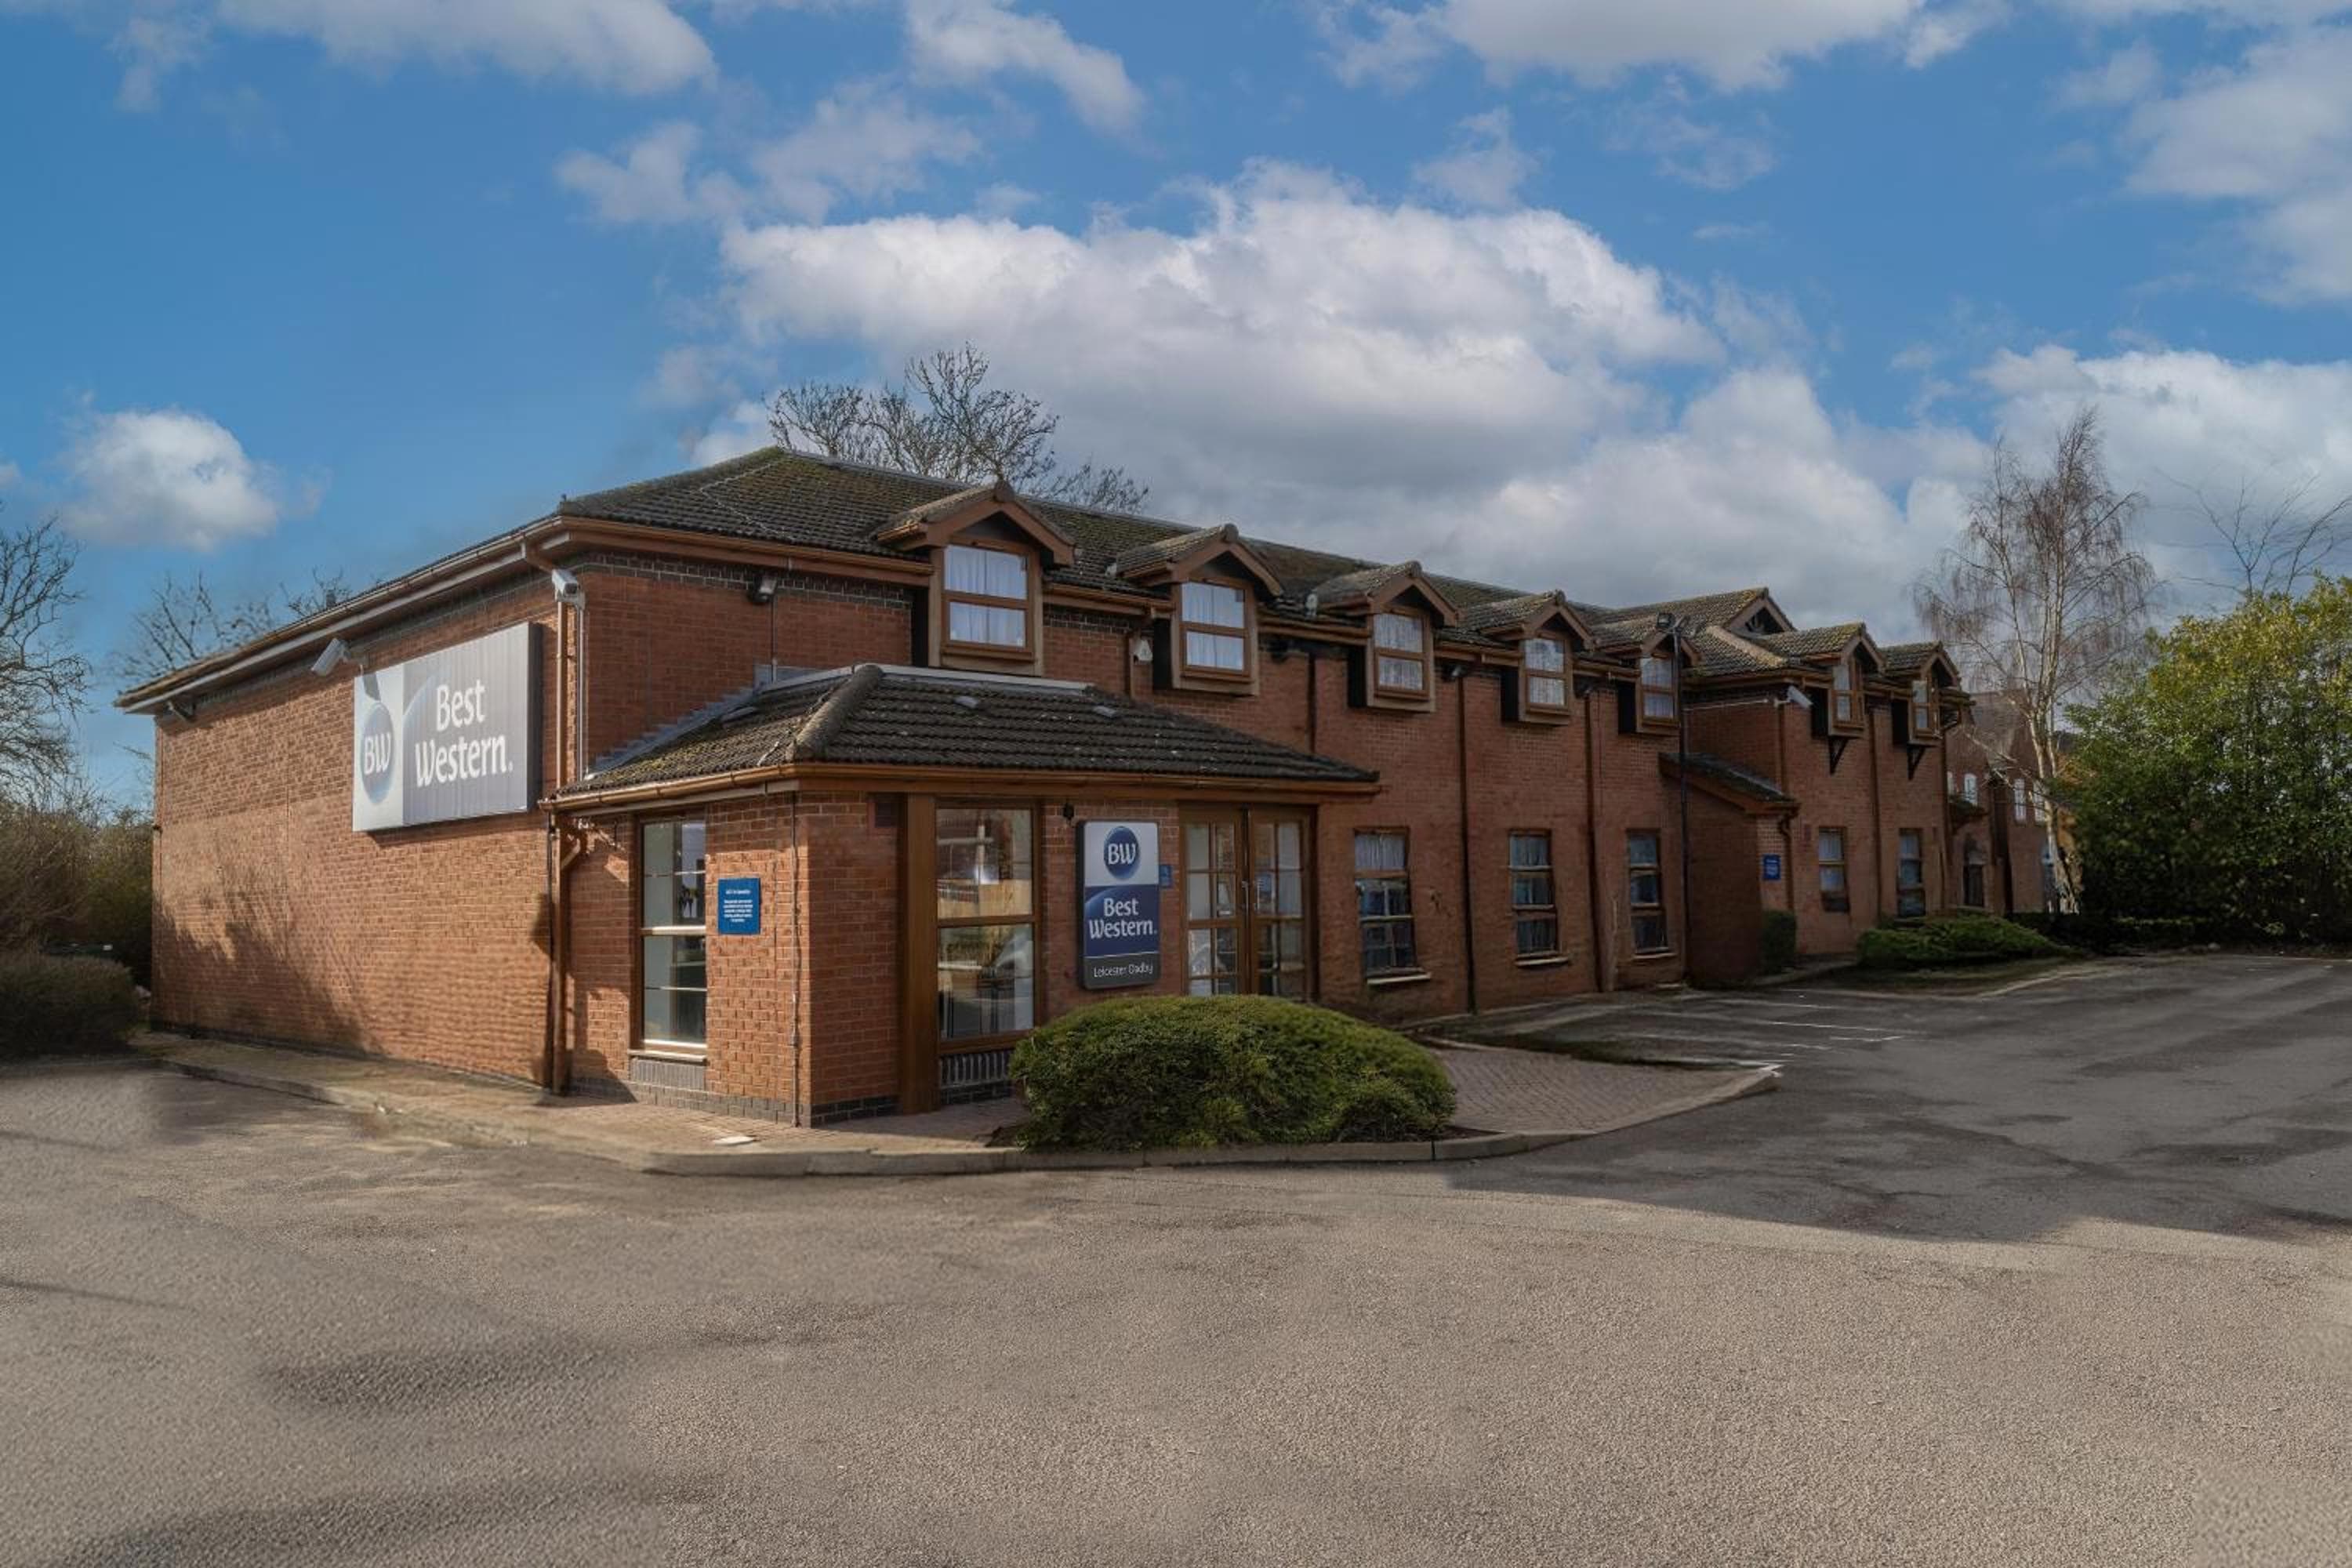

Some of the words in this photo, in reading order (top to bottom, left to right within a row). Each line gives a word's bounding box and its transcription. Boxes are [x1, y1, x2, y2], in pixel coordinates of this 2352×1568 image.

[436, 680, 486, 731] Best
[364, 733, 391, 775] BW
[1108, 843, 1136, 865] BW
[1103, 898, 1138, 916] Best
